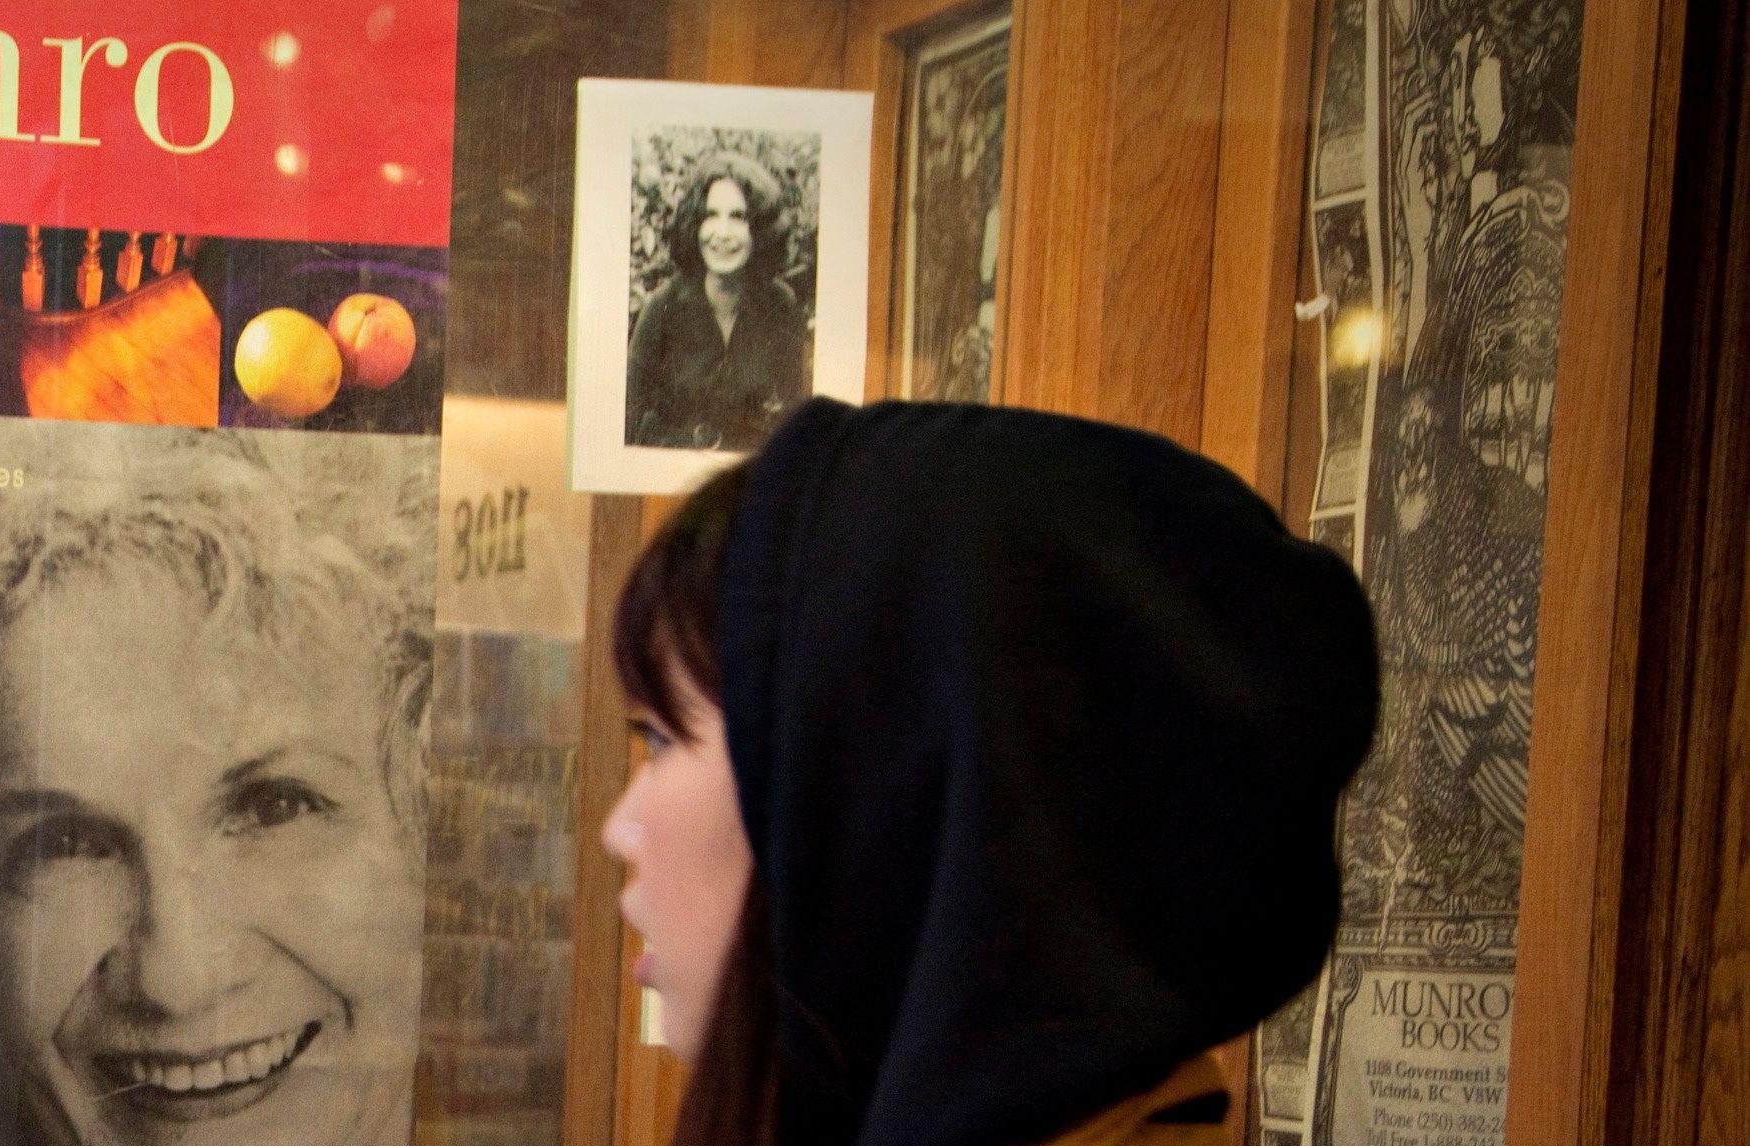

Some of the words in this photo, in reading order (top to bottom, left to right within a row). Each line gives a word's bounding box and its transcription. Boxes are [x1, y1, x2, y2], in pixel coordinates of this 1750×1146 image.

[1370, 979, 1511, 1021] MUNRO
[1400, 1020, 1500, 1052] BOOKS
[1395, 1061, 1490, 1083] Government
